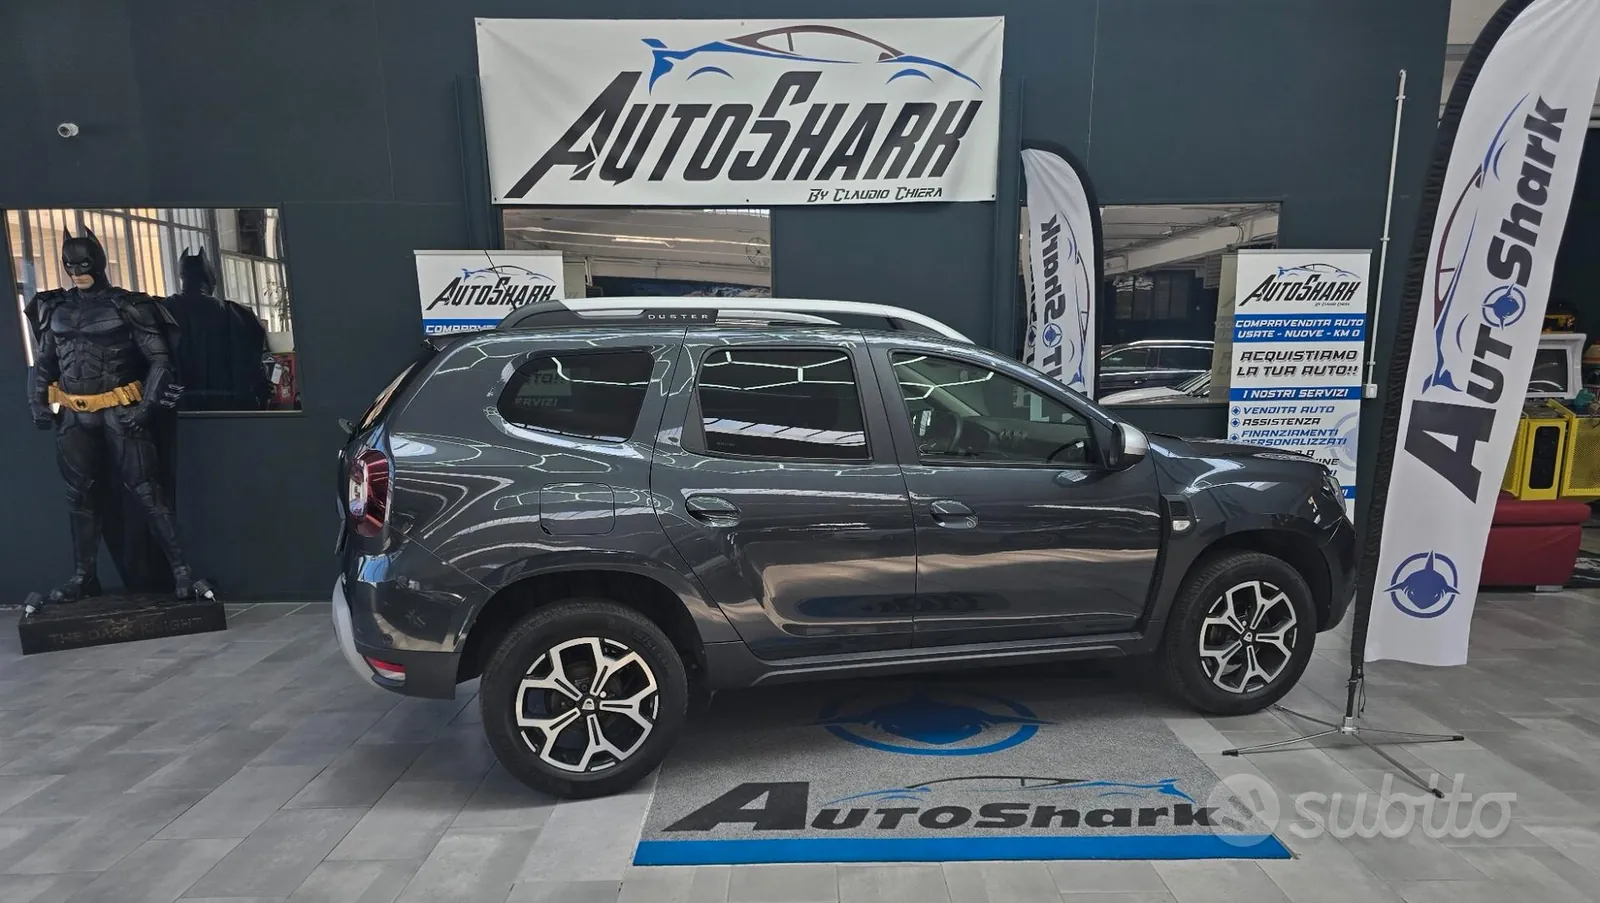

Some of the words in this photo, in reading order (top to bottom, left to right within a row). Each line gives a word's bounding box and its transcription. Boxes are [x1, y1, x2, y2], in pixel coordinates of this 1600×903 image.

[1235, 319, 1331, 328] COMPRAVENDITA
[1334, 318, 1364, 327] AUTO
[1237, 330, 1275, 339] USATE
[1284, 330, 1324, 338] NUOVE
[1333, 329, 1350, 337] KM
[1240, 350, 1358, 363] ACQUISTIAMO
[1236, 366, 1259, 377] LA
[1263, 366, 1297, 377] TUA
[1301, 365, 1359, 377] AUTO!!
[1243, 390, 1248, 399] I
[1250, 389, 1296, 399] NOSTRI
[1298, 388, 1349, 398] SERVIZI
[1243, 406, 1298, 415] VENDITA
[1300, 405, 1335, 414] AUTO
[1242, 417, 1321, 427] ASSISTENZA
[1241, 428, 1339, 438] FINANZIAMENTI
